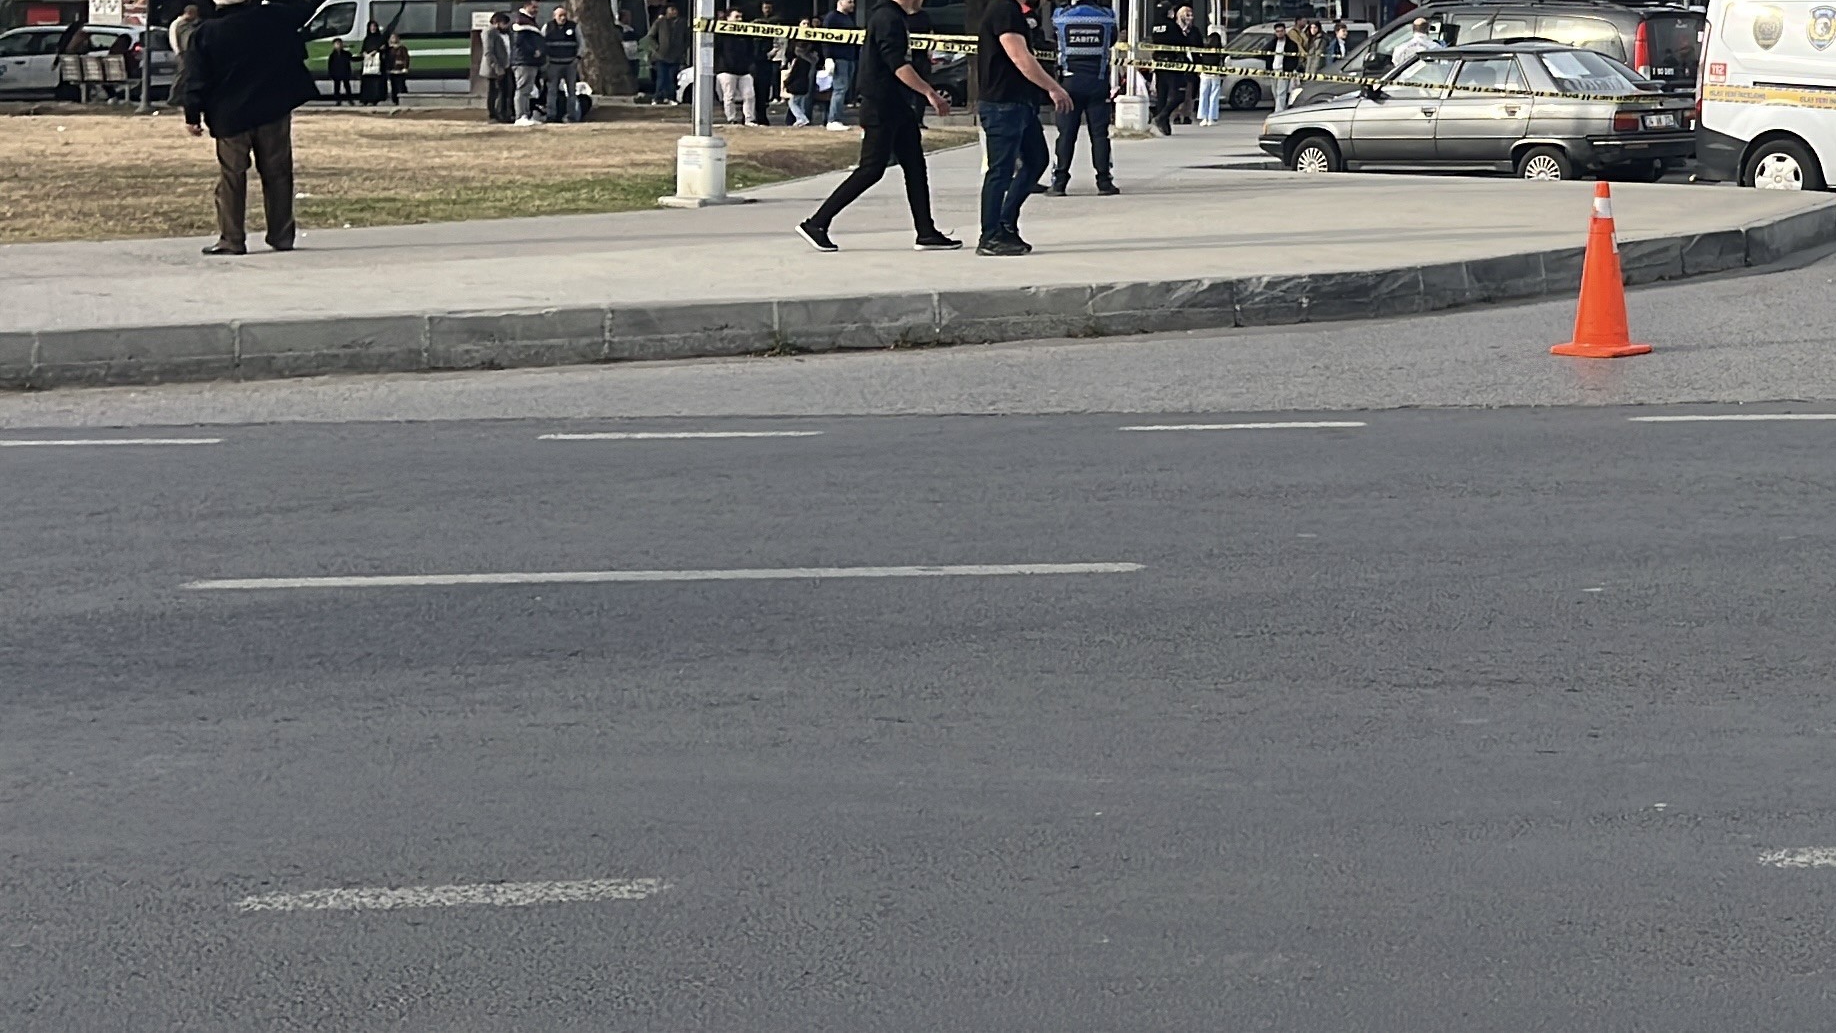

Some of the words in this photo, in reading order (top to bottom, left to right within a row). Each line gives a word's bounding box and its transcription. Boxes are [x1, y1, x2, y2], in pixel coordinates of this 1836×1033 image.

[719, 22, 784, 36] GIRILMEZ
[804, 30, 844, 42] POLIS
[1710, 64, 1726, 75] 112
